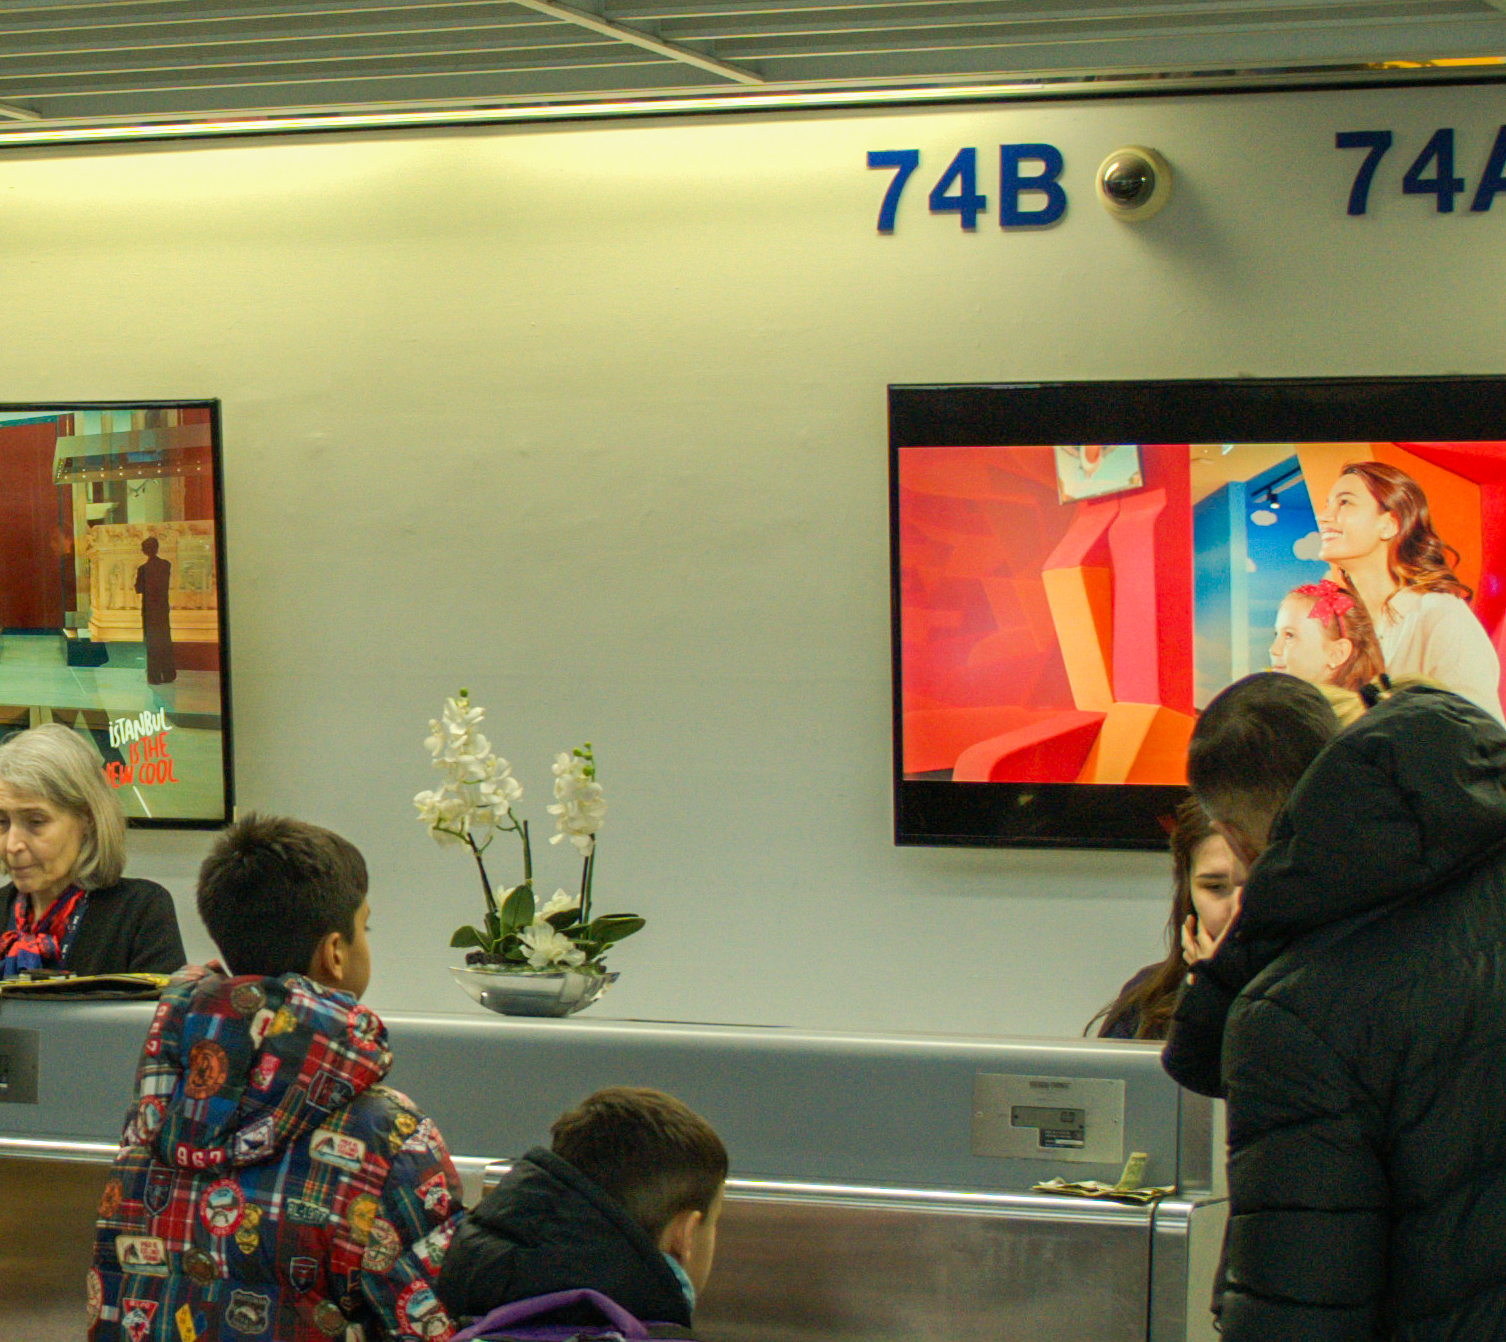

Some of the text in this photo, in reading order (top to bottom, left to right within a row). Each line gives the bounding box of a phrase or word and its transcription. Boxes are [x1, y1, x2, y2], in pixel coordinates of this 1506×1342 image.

[866, 143, 1068, 234] 74B
[129, 732, 170, 765] IS THE
[139, 758, 179, 785] COOL
[177, 1146, 222, 1167] 967
